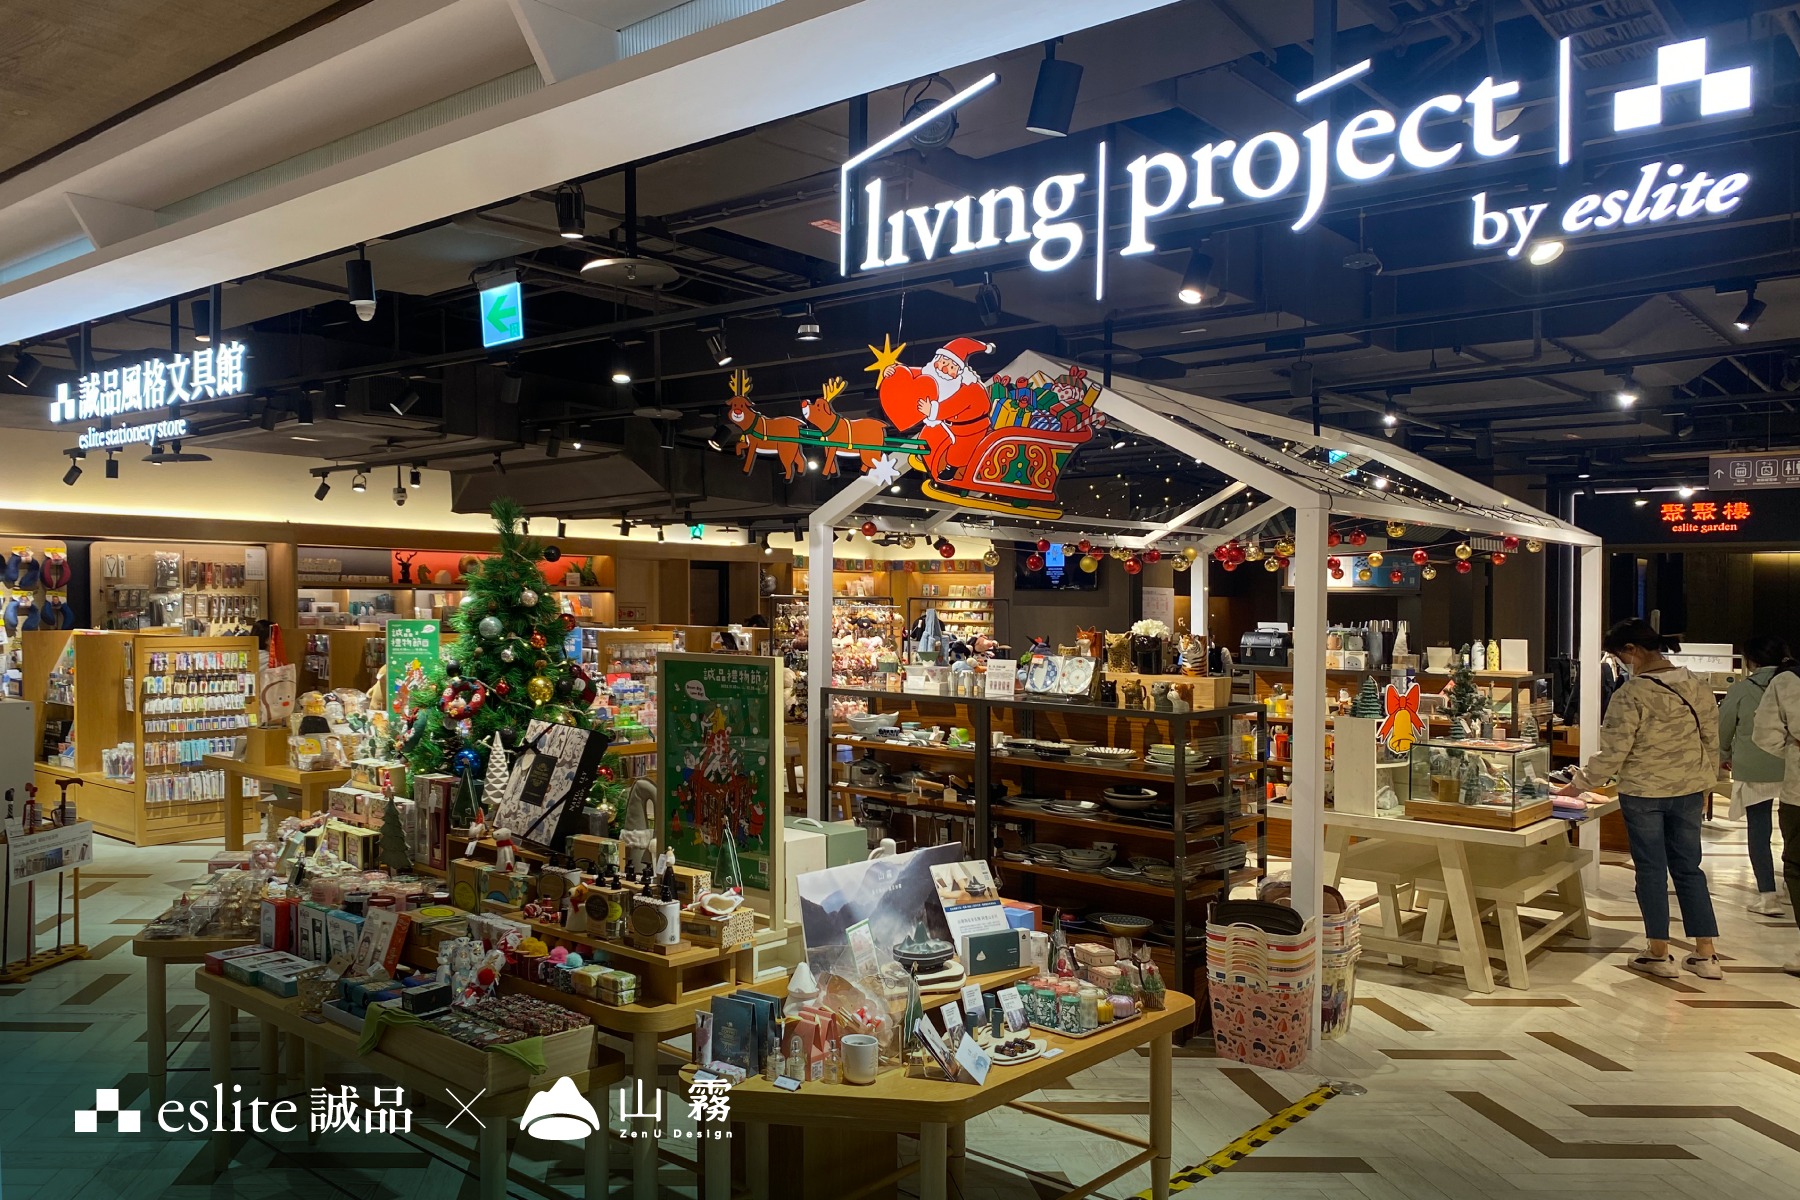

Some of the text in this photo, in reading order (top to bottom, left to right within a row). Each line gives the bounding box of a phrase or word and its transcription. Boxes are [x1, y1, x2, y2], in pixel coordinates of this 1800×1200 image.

[859, 75, 1520, 272] living project
[1472, 163, 1751, 259] by eslite
[78, 341, 246, 420] 誠品風格文具館
[78, 419, 187, 449] eslite stationery store
[1660, 501, 1751, 522] 聚聚樓
[1672, 522, 1738, 534] eslite garden
